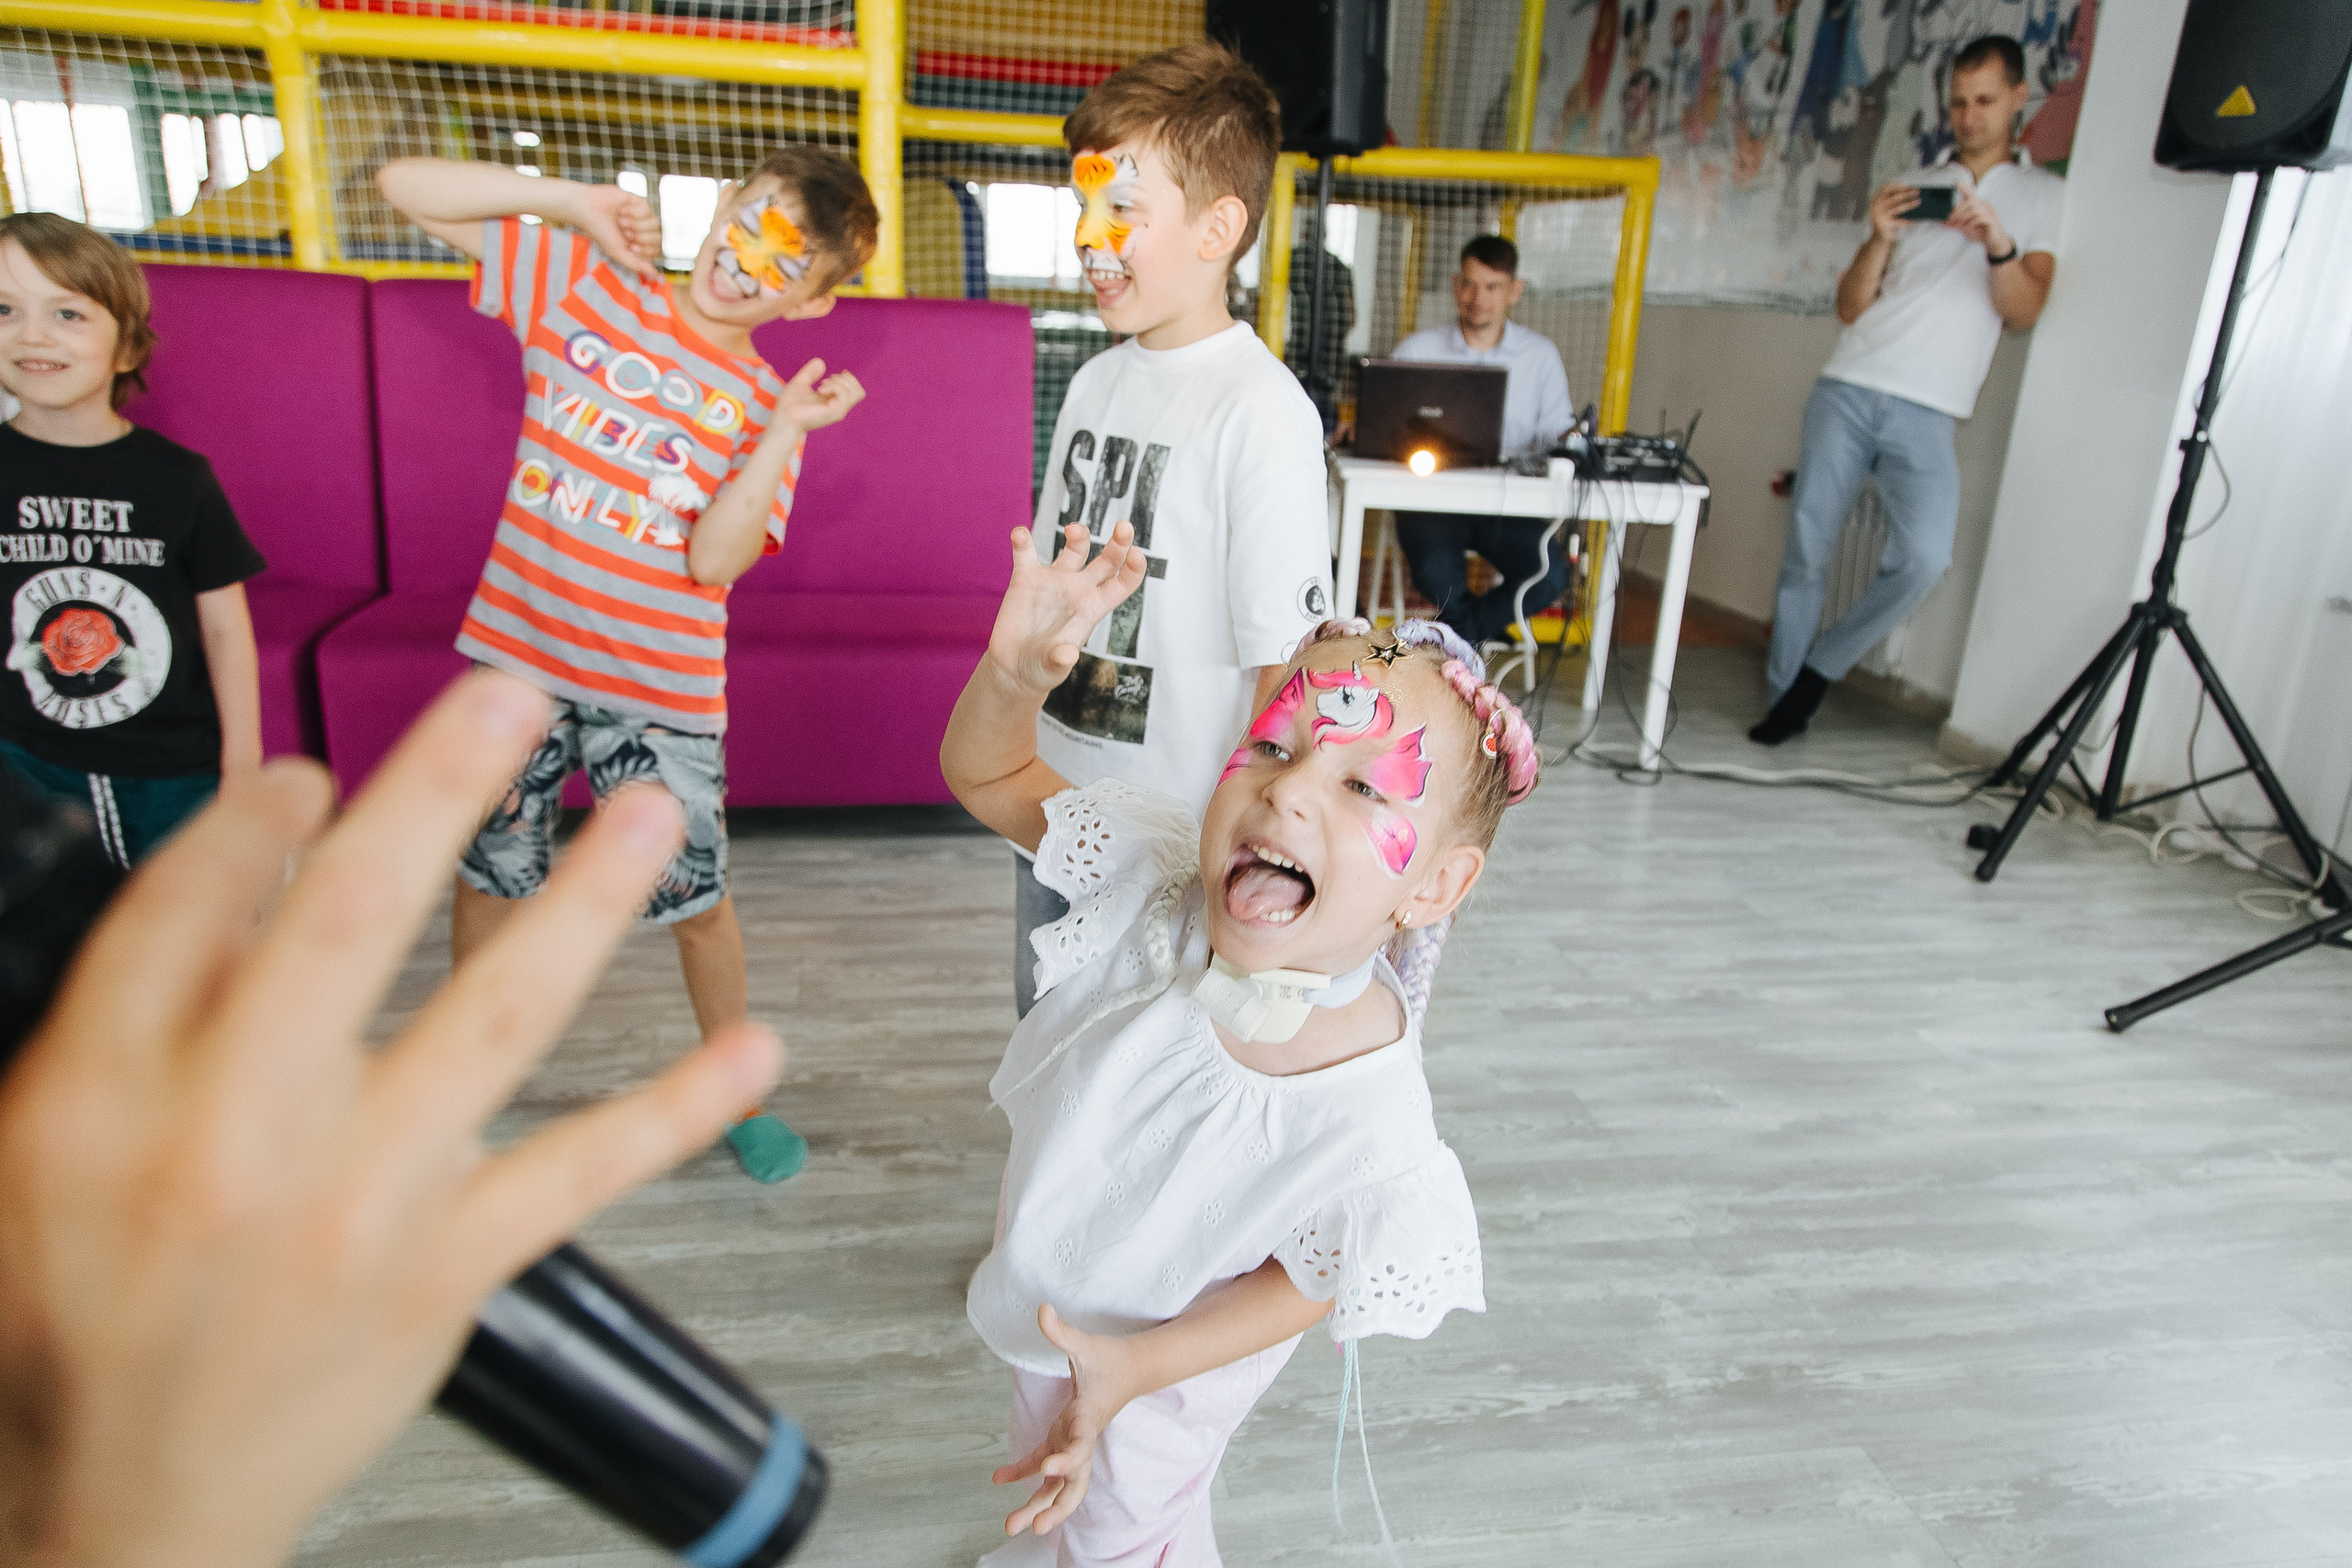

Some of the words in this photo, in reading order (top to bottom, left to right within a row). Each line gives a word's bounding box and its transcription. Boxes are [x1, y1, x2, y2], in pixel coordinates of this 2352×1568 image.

[564, 330, 745, 434] GOOD
[543, 378, 695, 472] VIBES
[17, 495, 133, 532] SWEET
[512, 458, 662, 543] ONLY
[0, 533, 69, 563] CHILD
